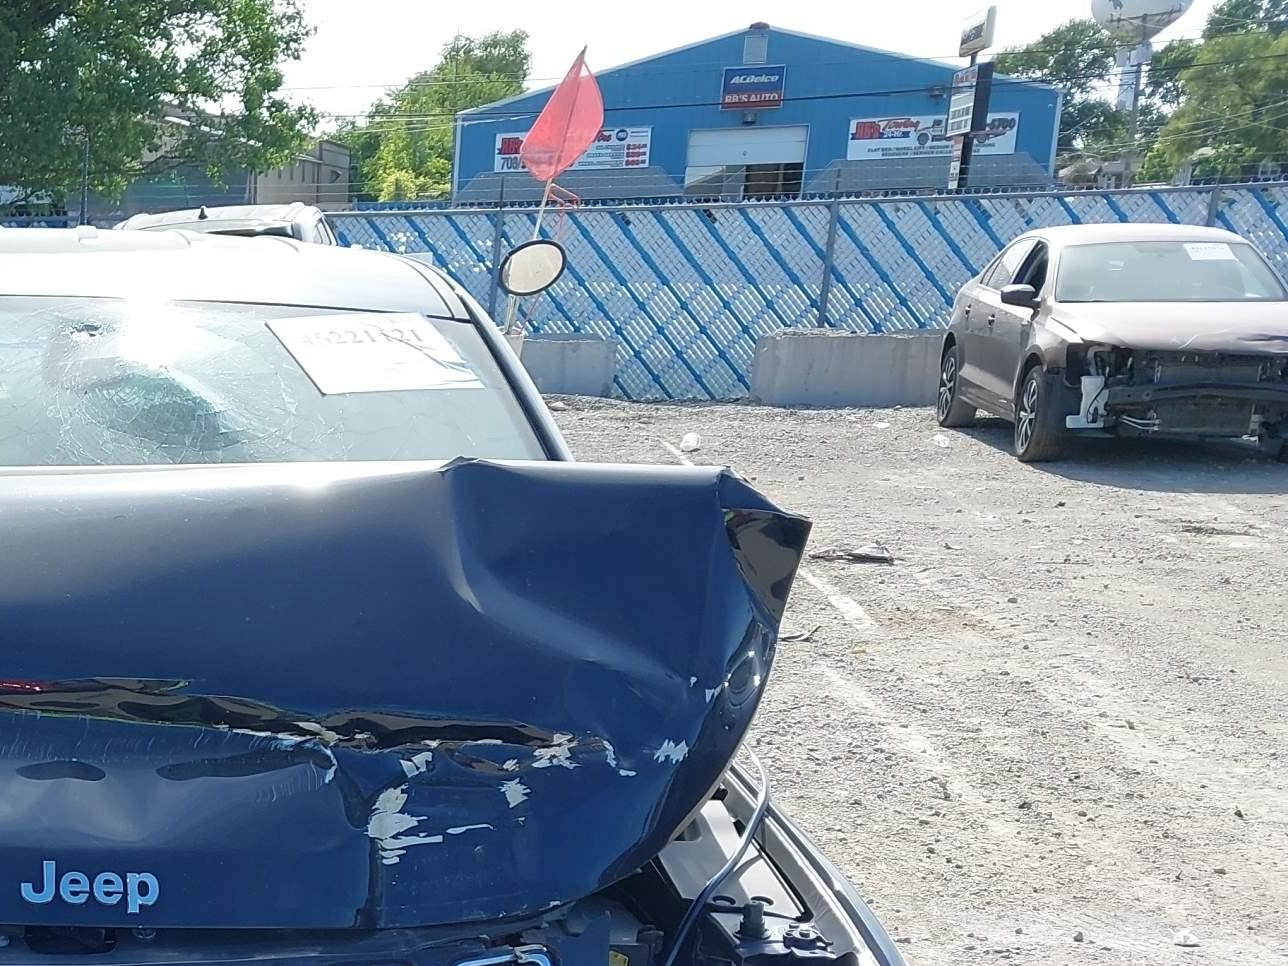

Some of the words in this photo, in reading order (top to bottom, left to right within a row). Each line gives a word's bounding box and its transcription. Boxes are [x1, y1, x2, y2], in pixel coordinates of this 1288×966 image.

[730, 74, 779, 84] ACDelco
[749, 93, 779, 102] AUTO
[20, 860, 160, 914] Jeep
